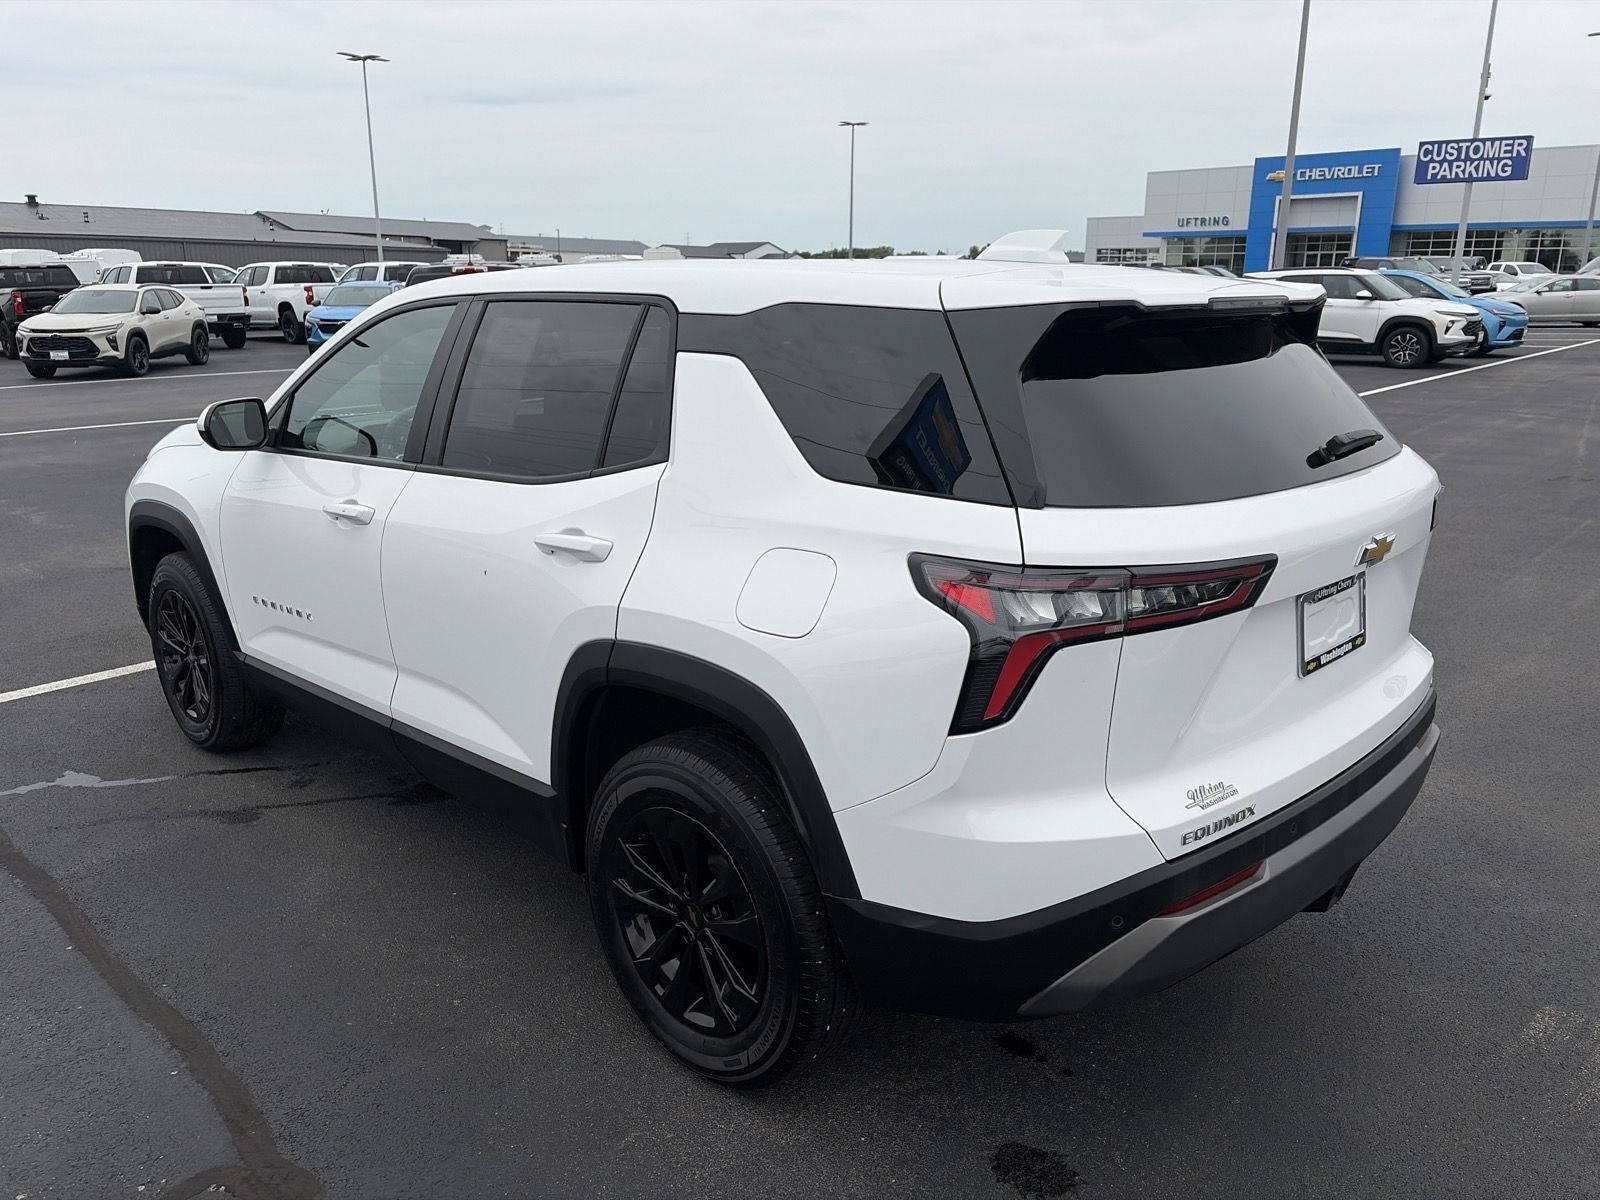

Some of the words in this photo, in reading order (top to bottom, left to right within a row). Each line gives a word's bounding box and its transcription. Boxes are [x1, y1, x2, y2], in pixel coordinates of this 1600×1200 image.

[1420, 139, 1527, 161] CUSTOMER
[1296, 164, 1382, 181] CHEVROLET
[1427, 159, 1512, 180] PARKING
[1177, 216, 1230, 228] UFTRING
[1320, 642, 1353, 665] Washington
[1200, 789, 1239, 810] WASHINGTON
[1181, 803, 1256, 846] EQUINOX
